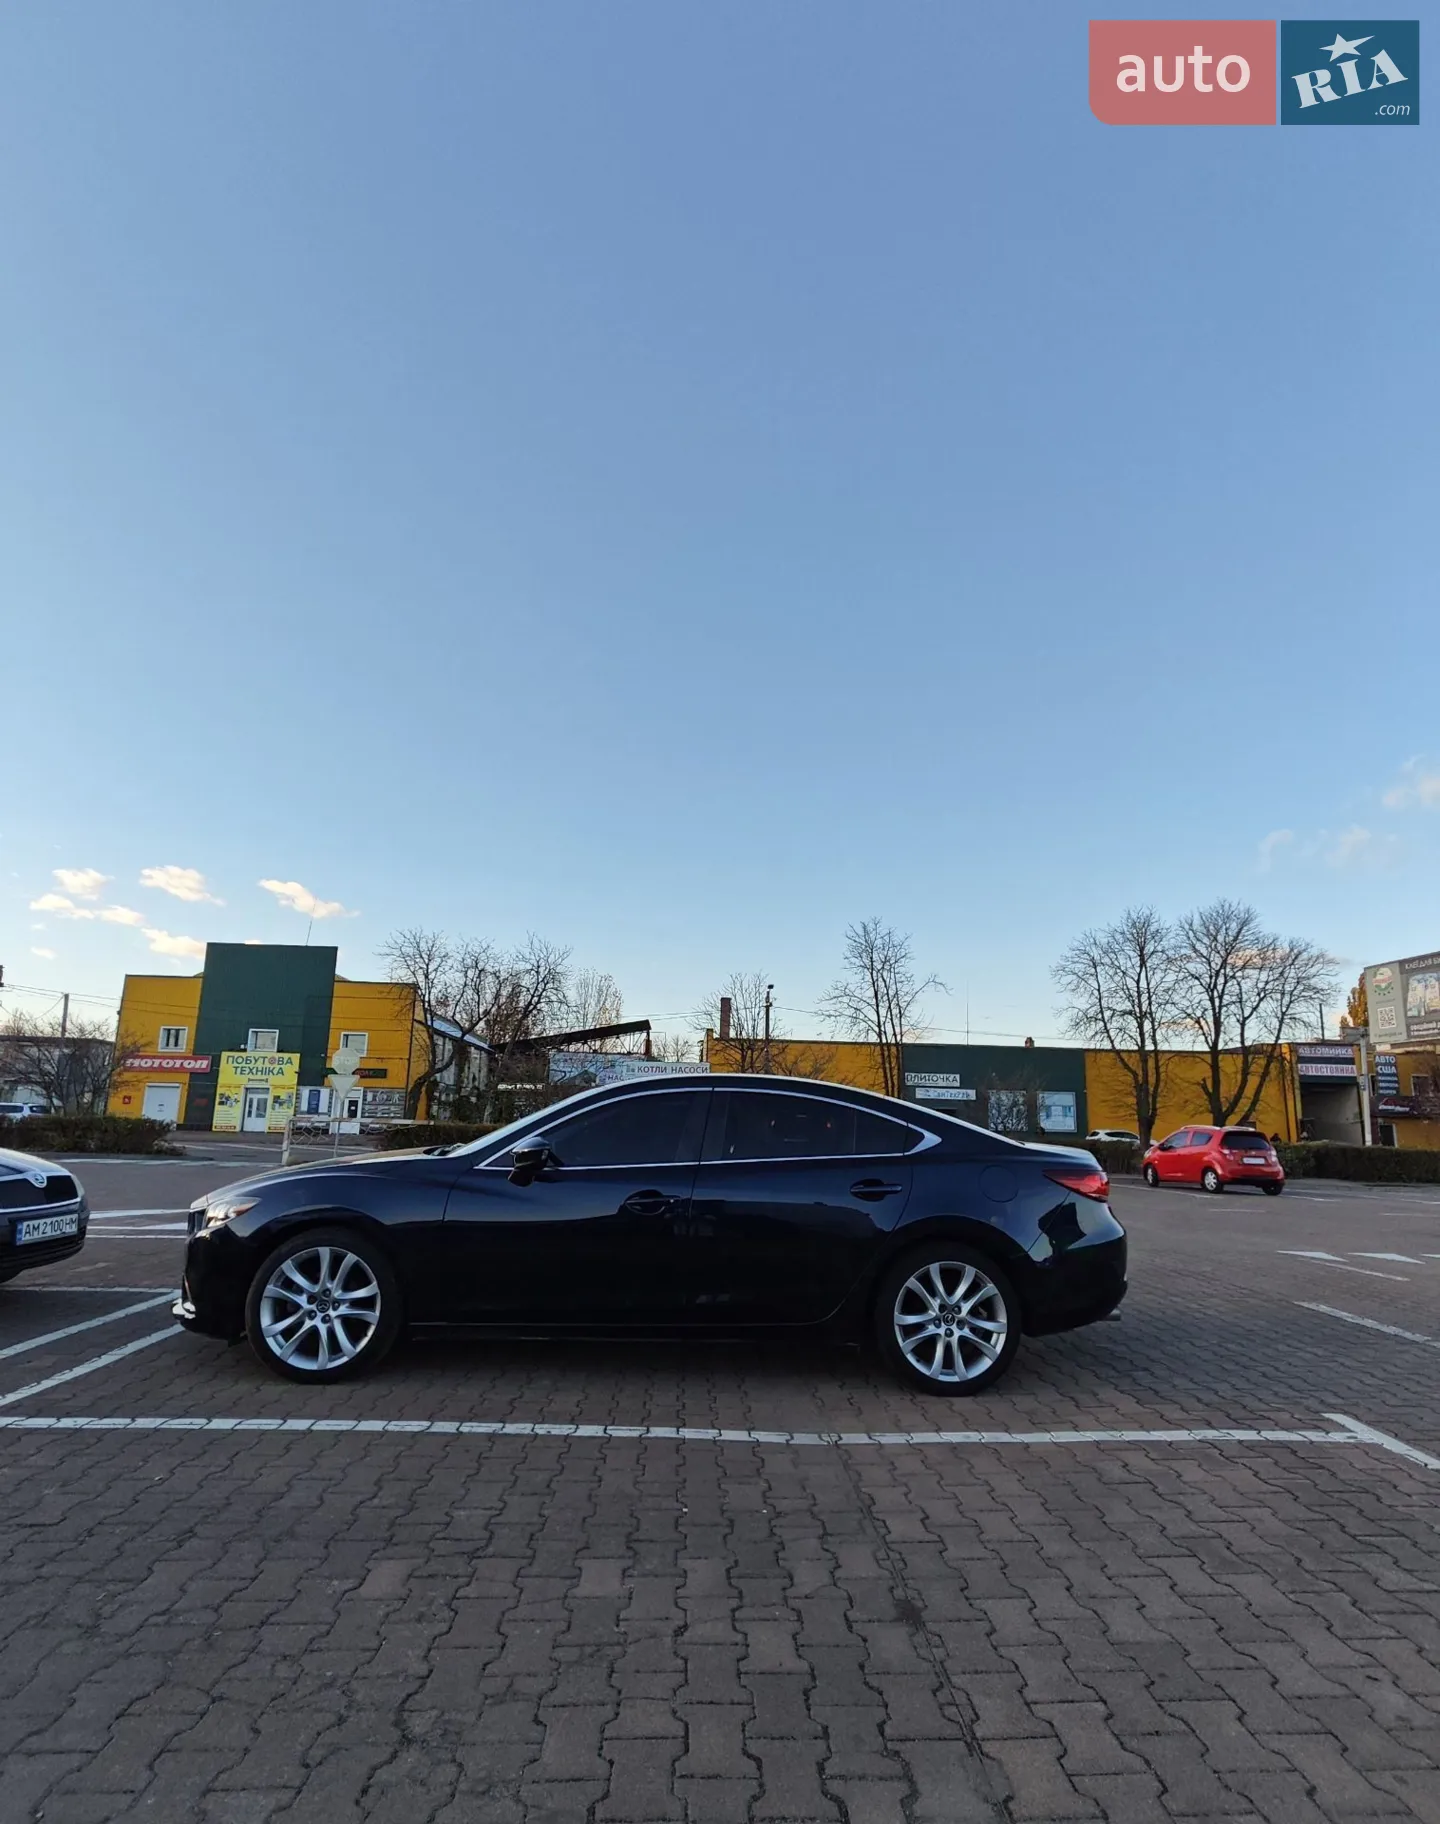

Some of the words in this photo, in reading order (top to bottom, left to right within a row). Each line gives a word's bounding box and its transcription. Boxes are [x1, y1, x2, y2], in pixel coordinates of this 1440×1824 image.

[226, 1055, 294, 1066] ПОБУТОВА
[1375, 1055, 1396, 1063] АВТО
[233, 1066, 285, 1076] ТЕХНІКА
[637, 1066, 667, 1074] КОТЛИ
[671, 1066, 708, 1074] НАСОСИ
[906, 1074, 958, 1083] ПЛИТОЧКА
